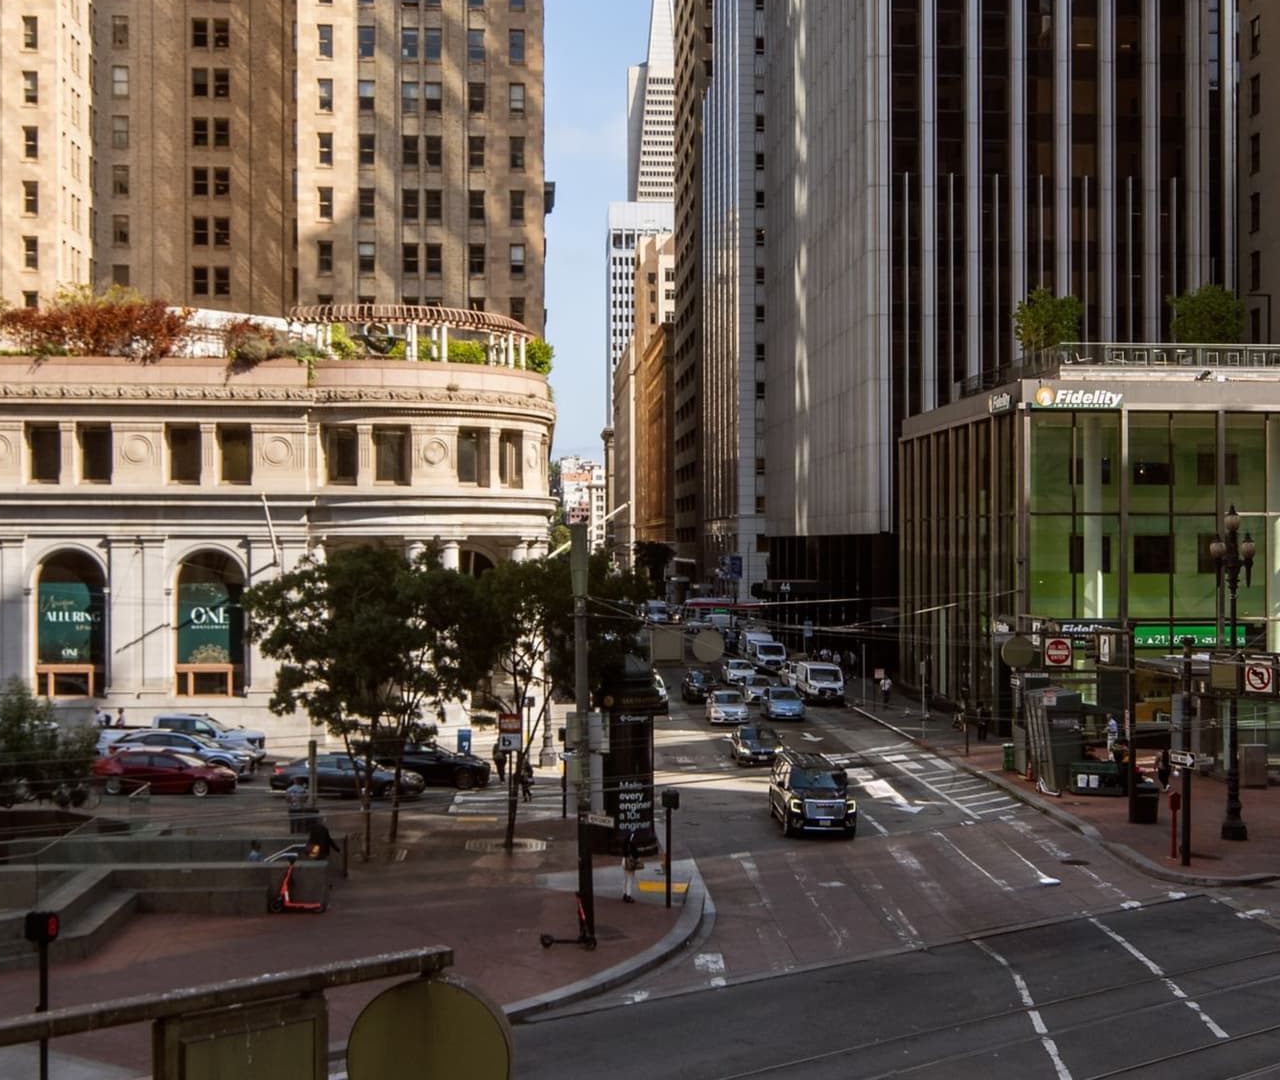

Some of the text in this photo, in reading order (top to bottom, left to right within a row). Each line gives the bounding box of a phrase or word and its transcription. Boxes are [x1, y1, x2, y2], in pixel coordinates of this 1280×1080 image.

[1055, 389, 1123, 407] Fidelity
[44, 611, 101, 622] ALLURING
[191, 607, 229, 624] ONE
[619, 792, 644, 801] every
[626, 812, 641, 821] 10x
